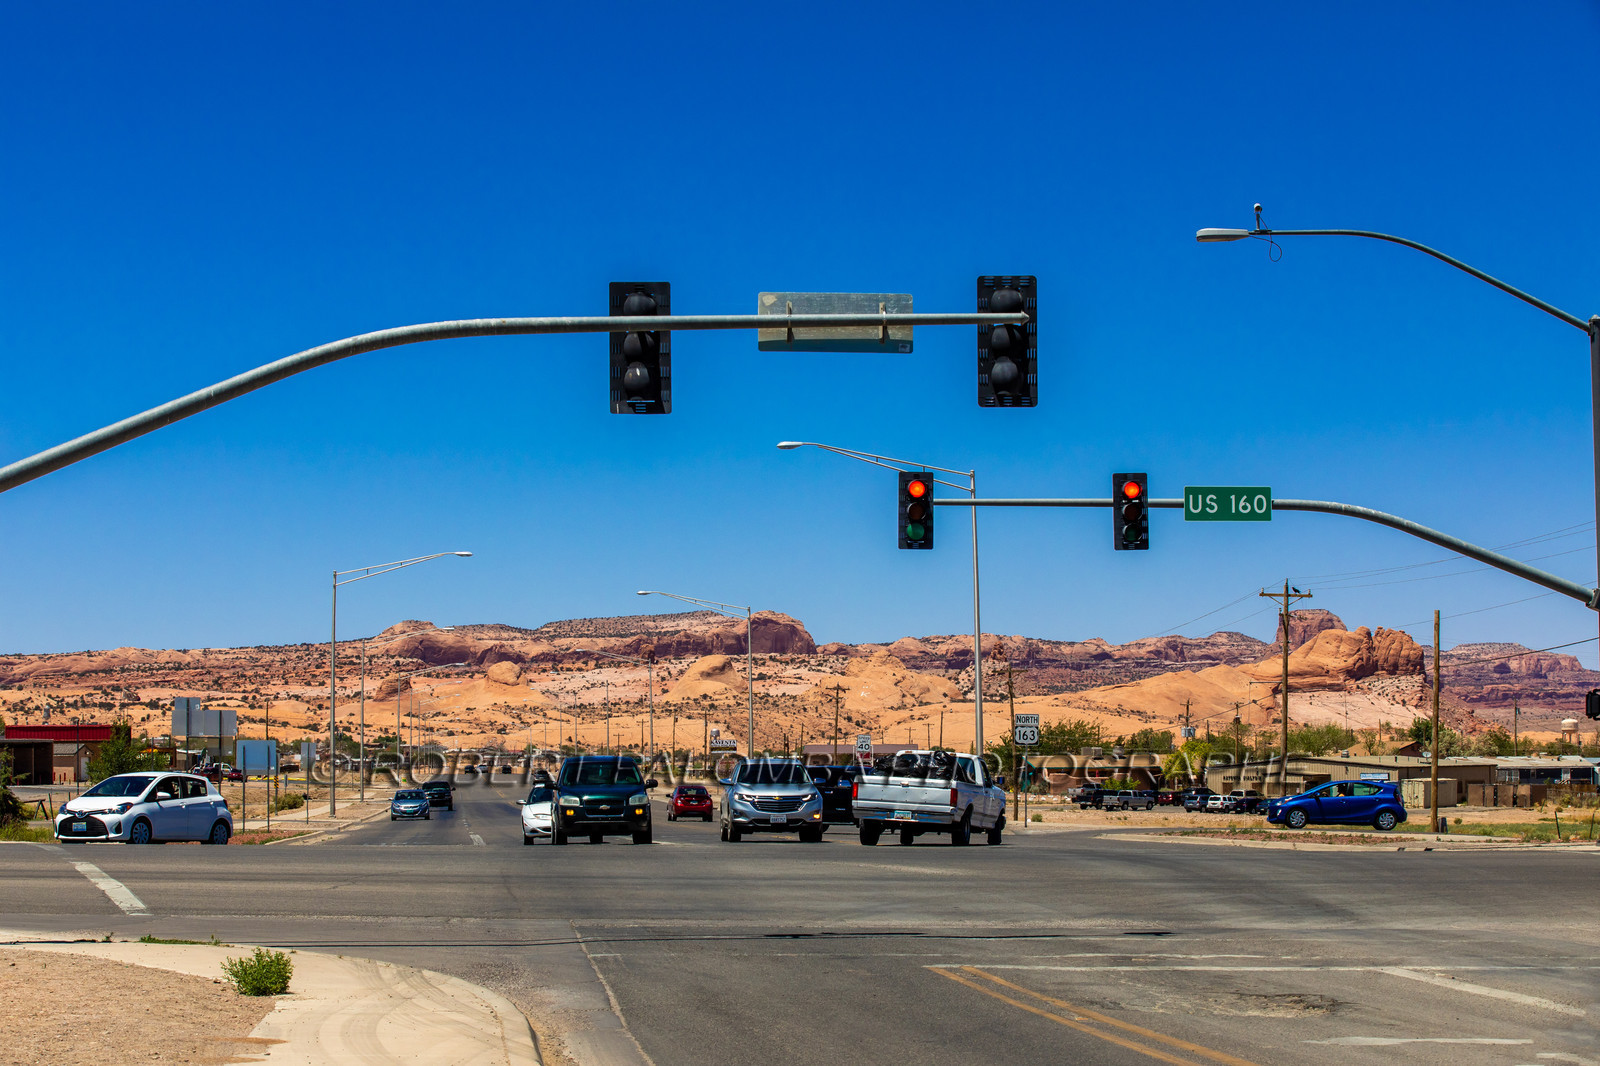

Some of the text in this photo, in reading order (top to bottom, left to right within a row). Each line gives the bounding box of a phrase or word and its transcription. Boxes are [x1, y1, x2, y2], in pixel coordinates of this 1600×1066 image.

[1189, 494, 1267, 513] US 160
[1016, 715, 1038, 724] NORTH
[1018, 730, 1036, 741] 163
